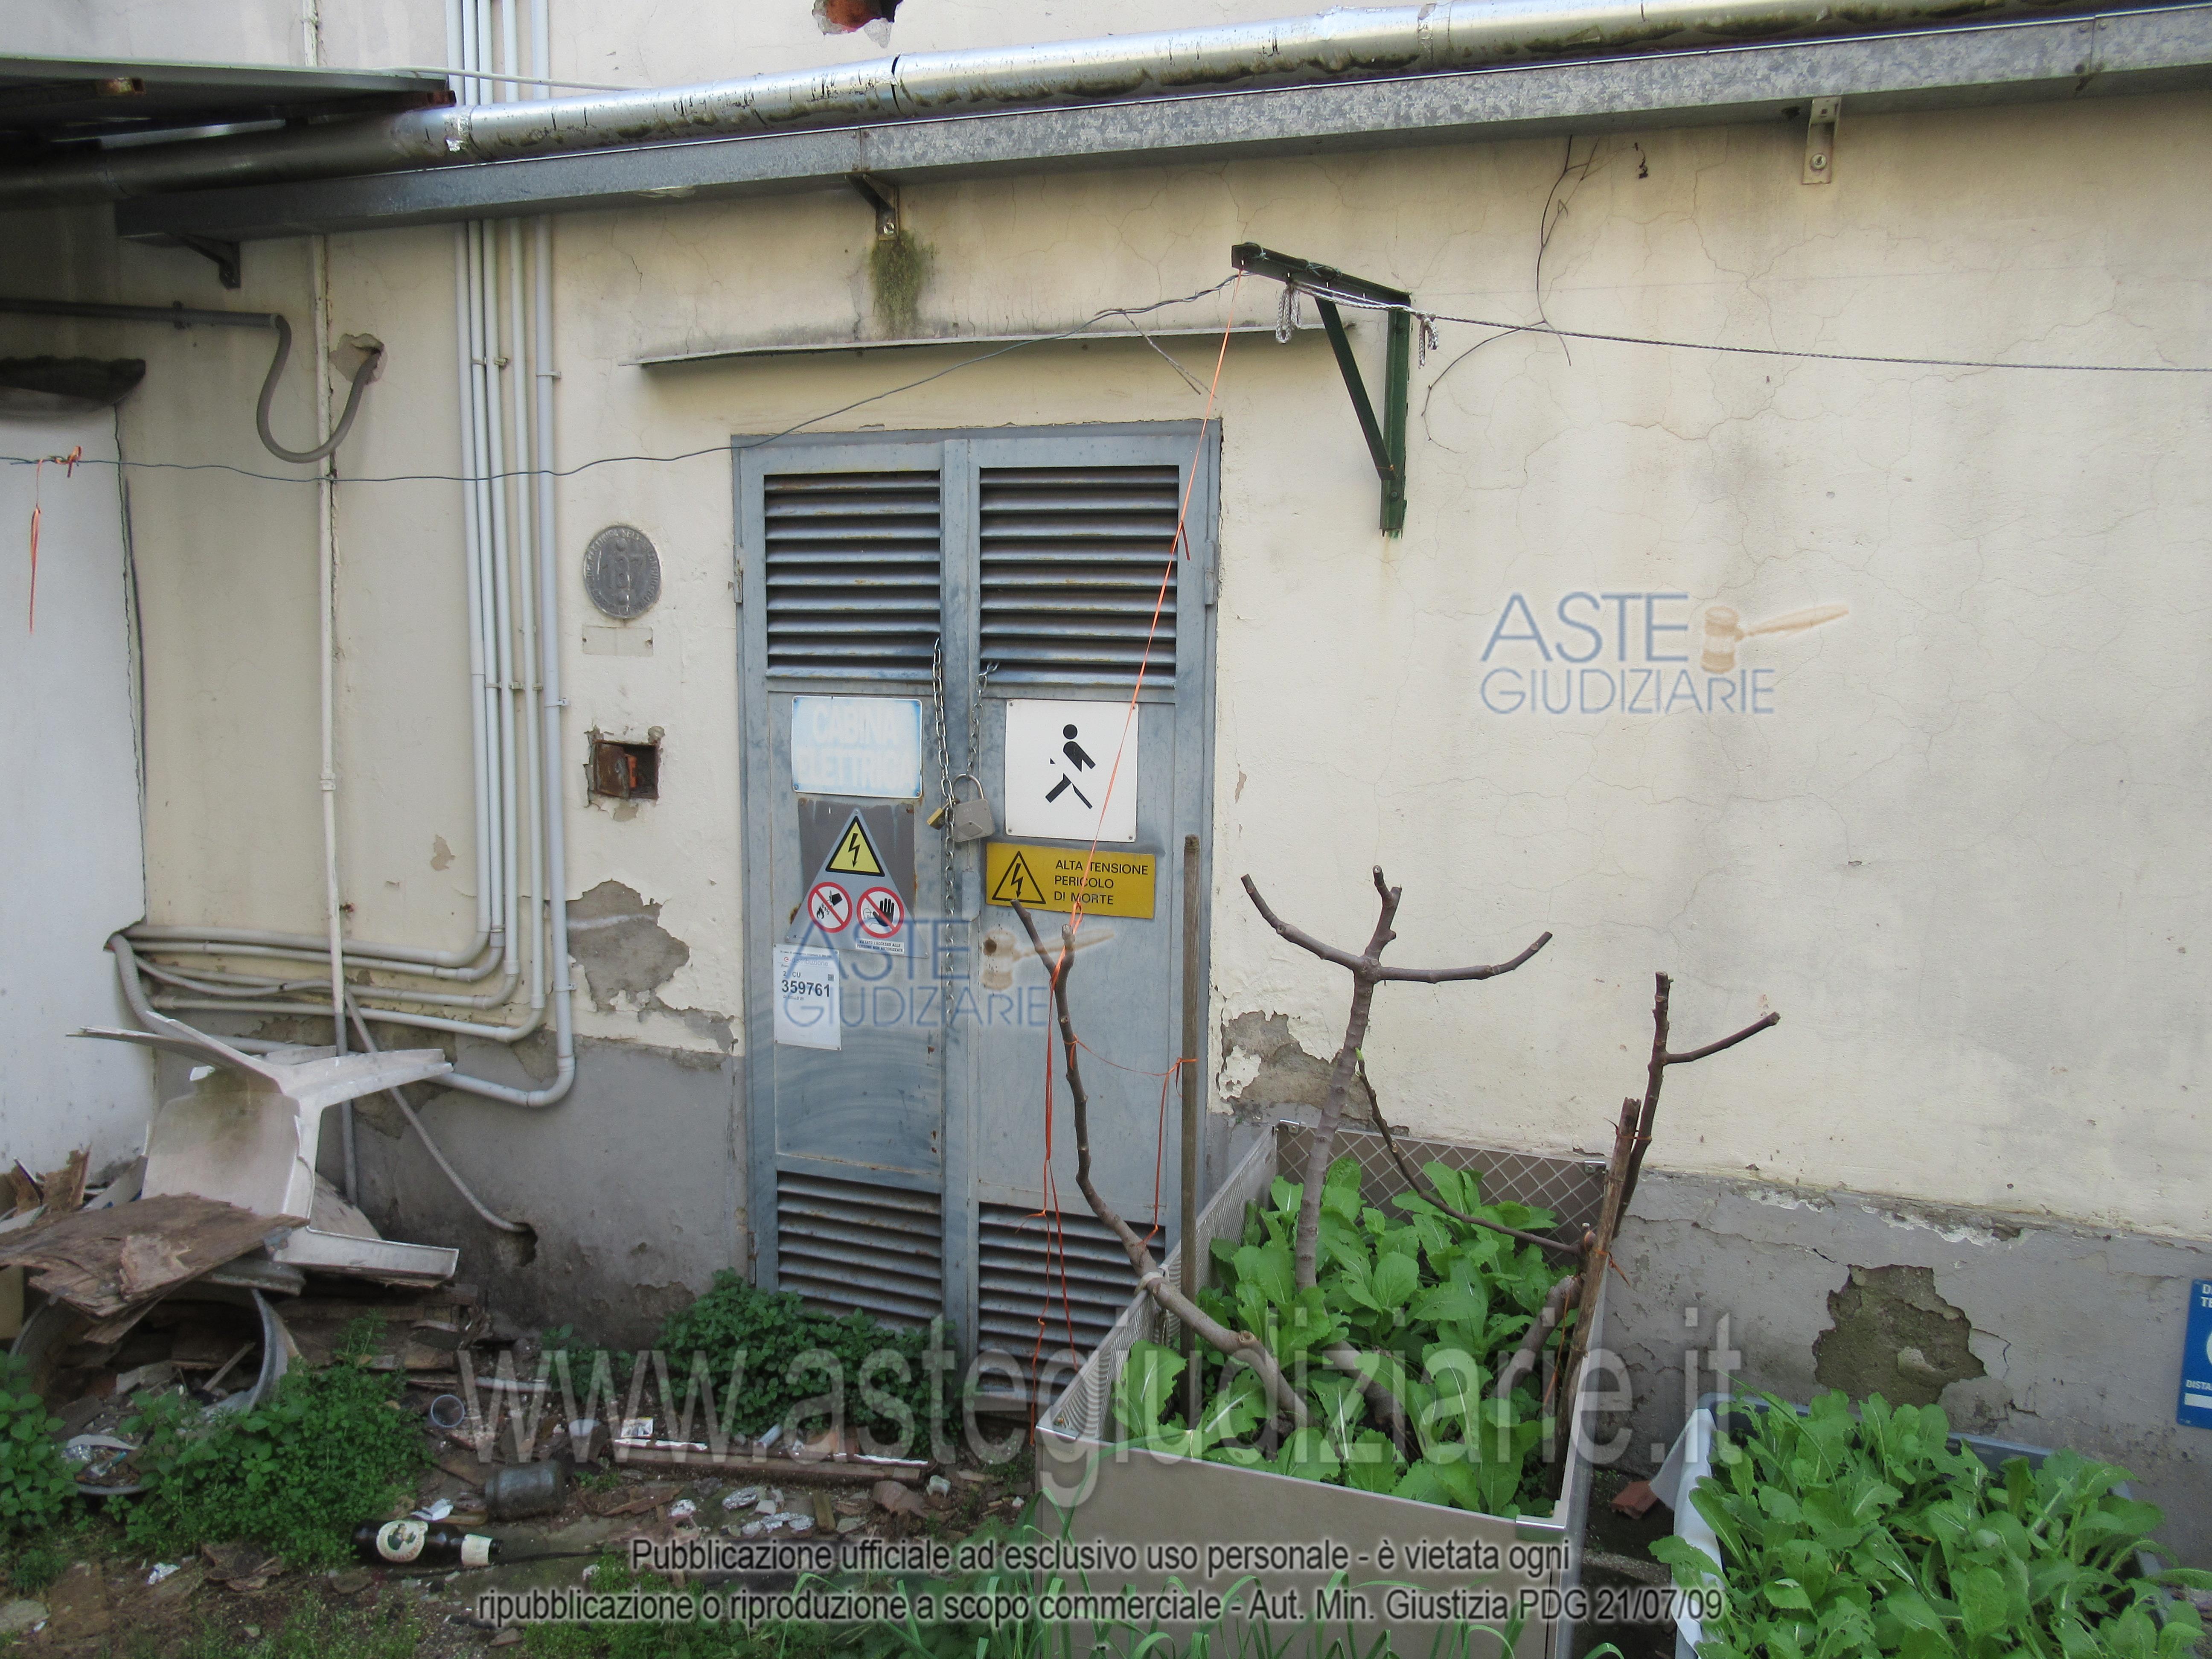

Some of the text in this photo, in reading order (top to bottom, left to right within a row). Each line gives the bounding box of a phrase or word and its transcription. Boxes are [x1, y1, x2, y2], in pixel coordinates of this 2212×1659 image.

[1056, 860, 1148, 875] ALTA TENSIONE
[1054, 876, 1114, 889] PERICOLO
[1054, 891, 1114, 905] DI MORTE
[781, 979, 830, 997] 359761
[2202, 1284, 2212, 1295] D
[2186, 1379, 2212, 1391] DISTA
